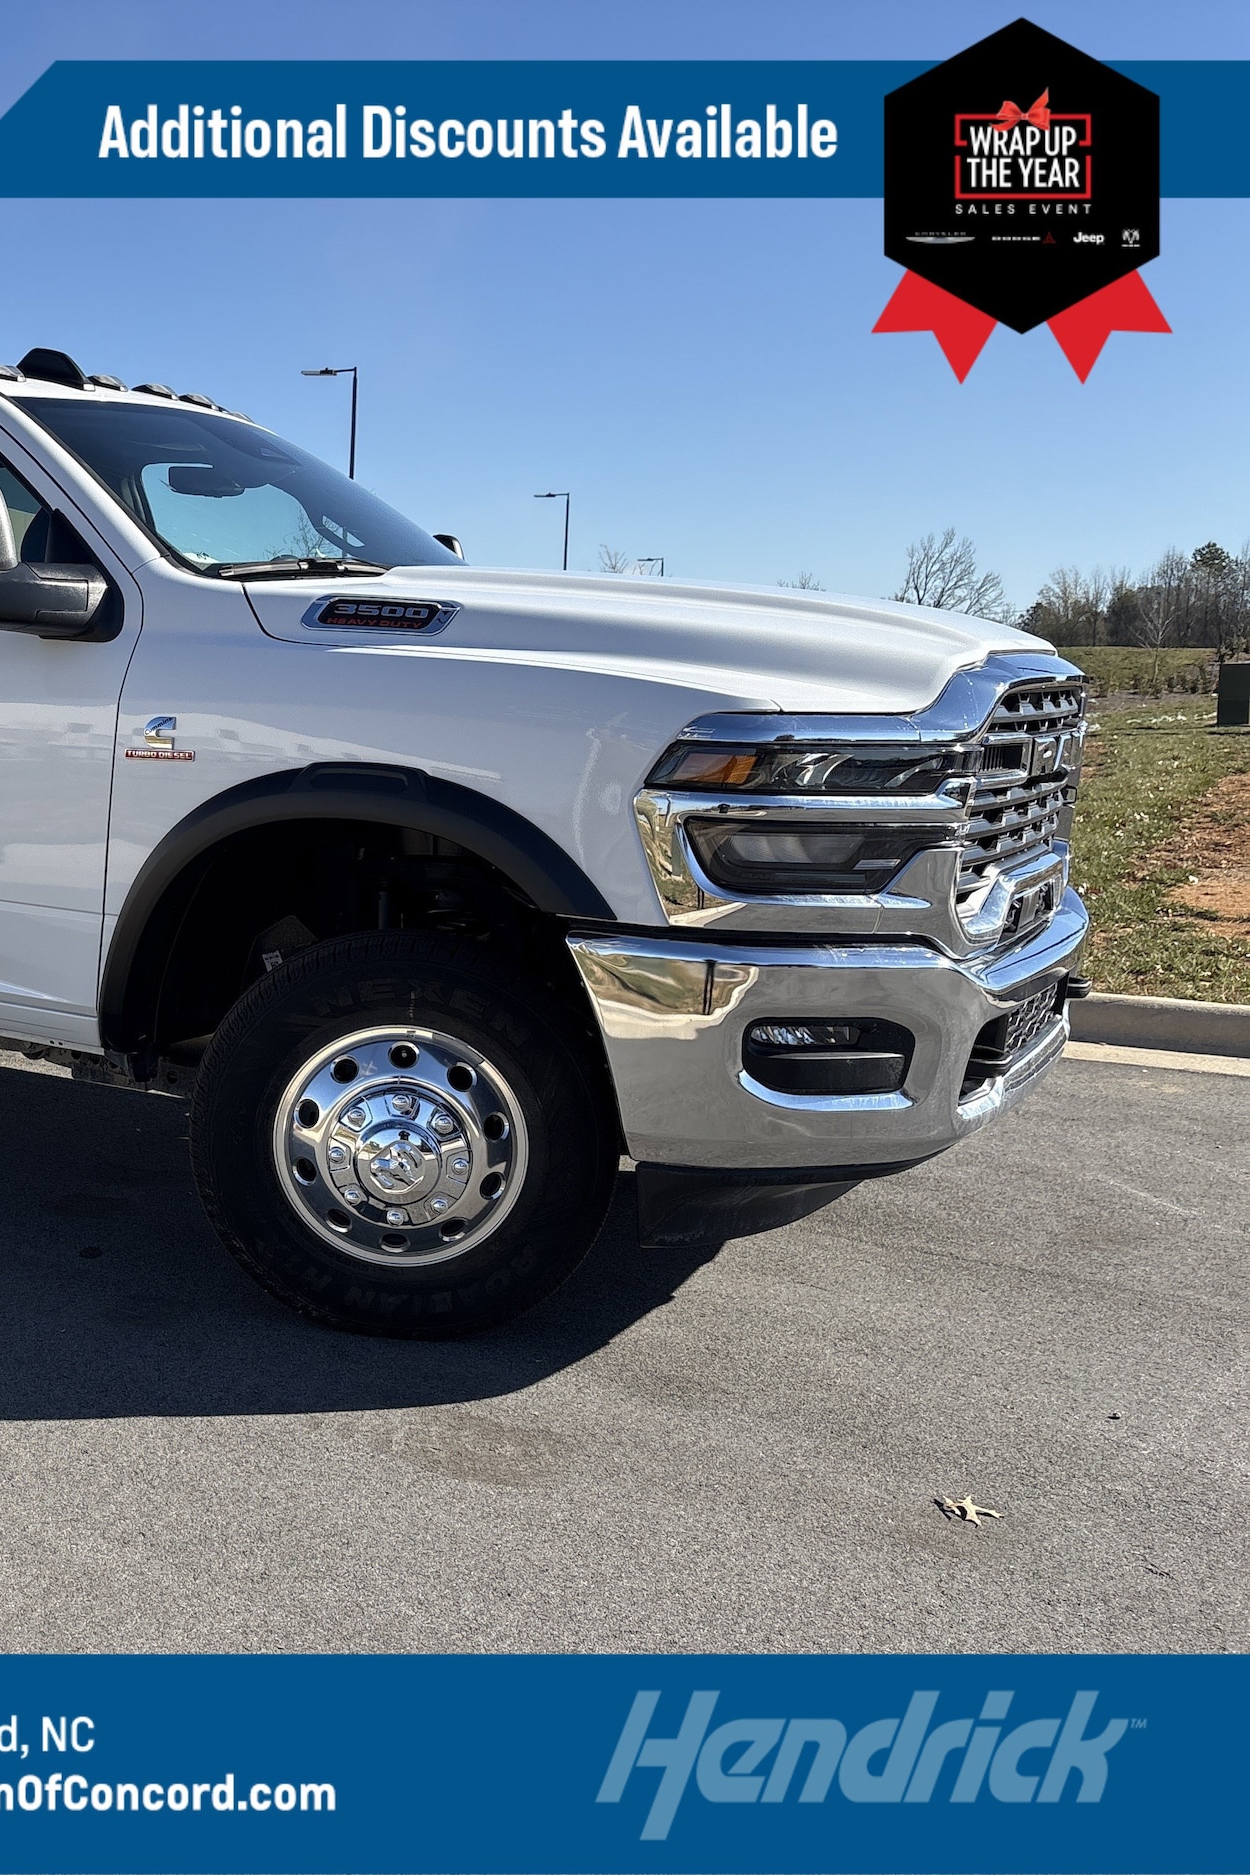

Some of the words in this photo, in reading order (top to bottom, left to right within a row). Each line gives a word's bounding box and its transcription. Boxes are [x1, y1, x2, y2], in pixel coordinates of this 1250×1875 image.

[334, 603, 430, 619] 3500
[326, 617, 378, 627] HEAVY
[379, 620, 423, 630] DUTY
[126, 750, 158, 758] TURBO
[158, 752, 192, 760] DIESEL
[310, 978, 533, 1048] NEXEN
